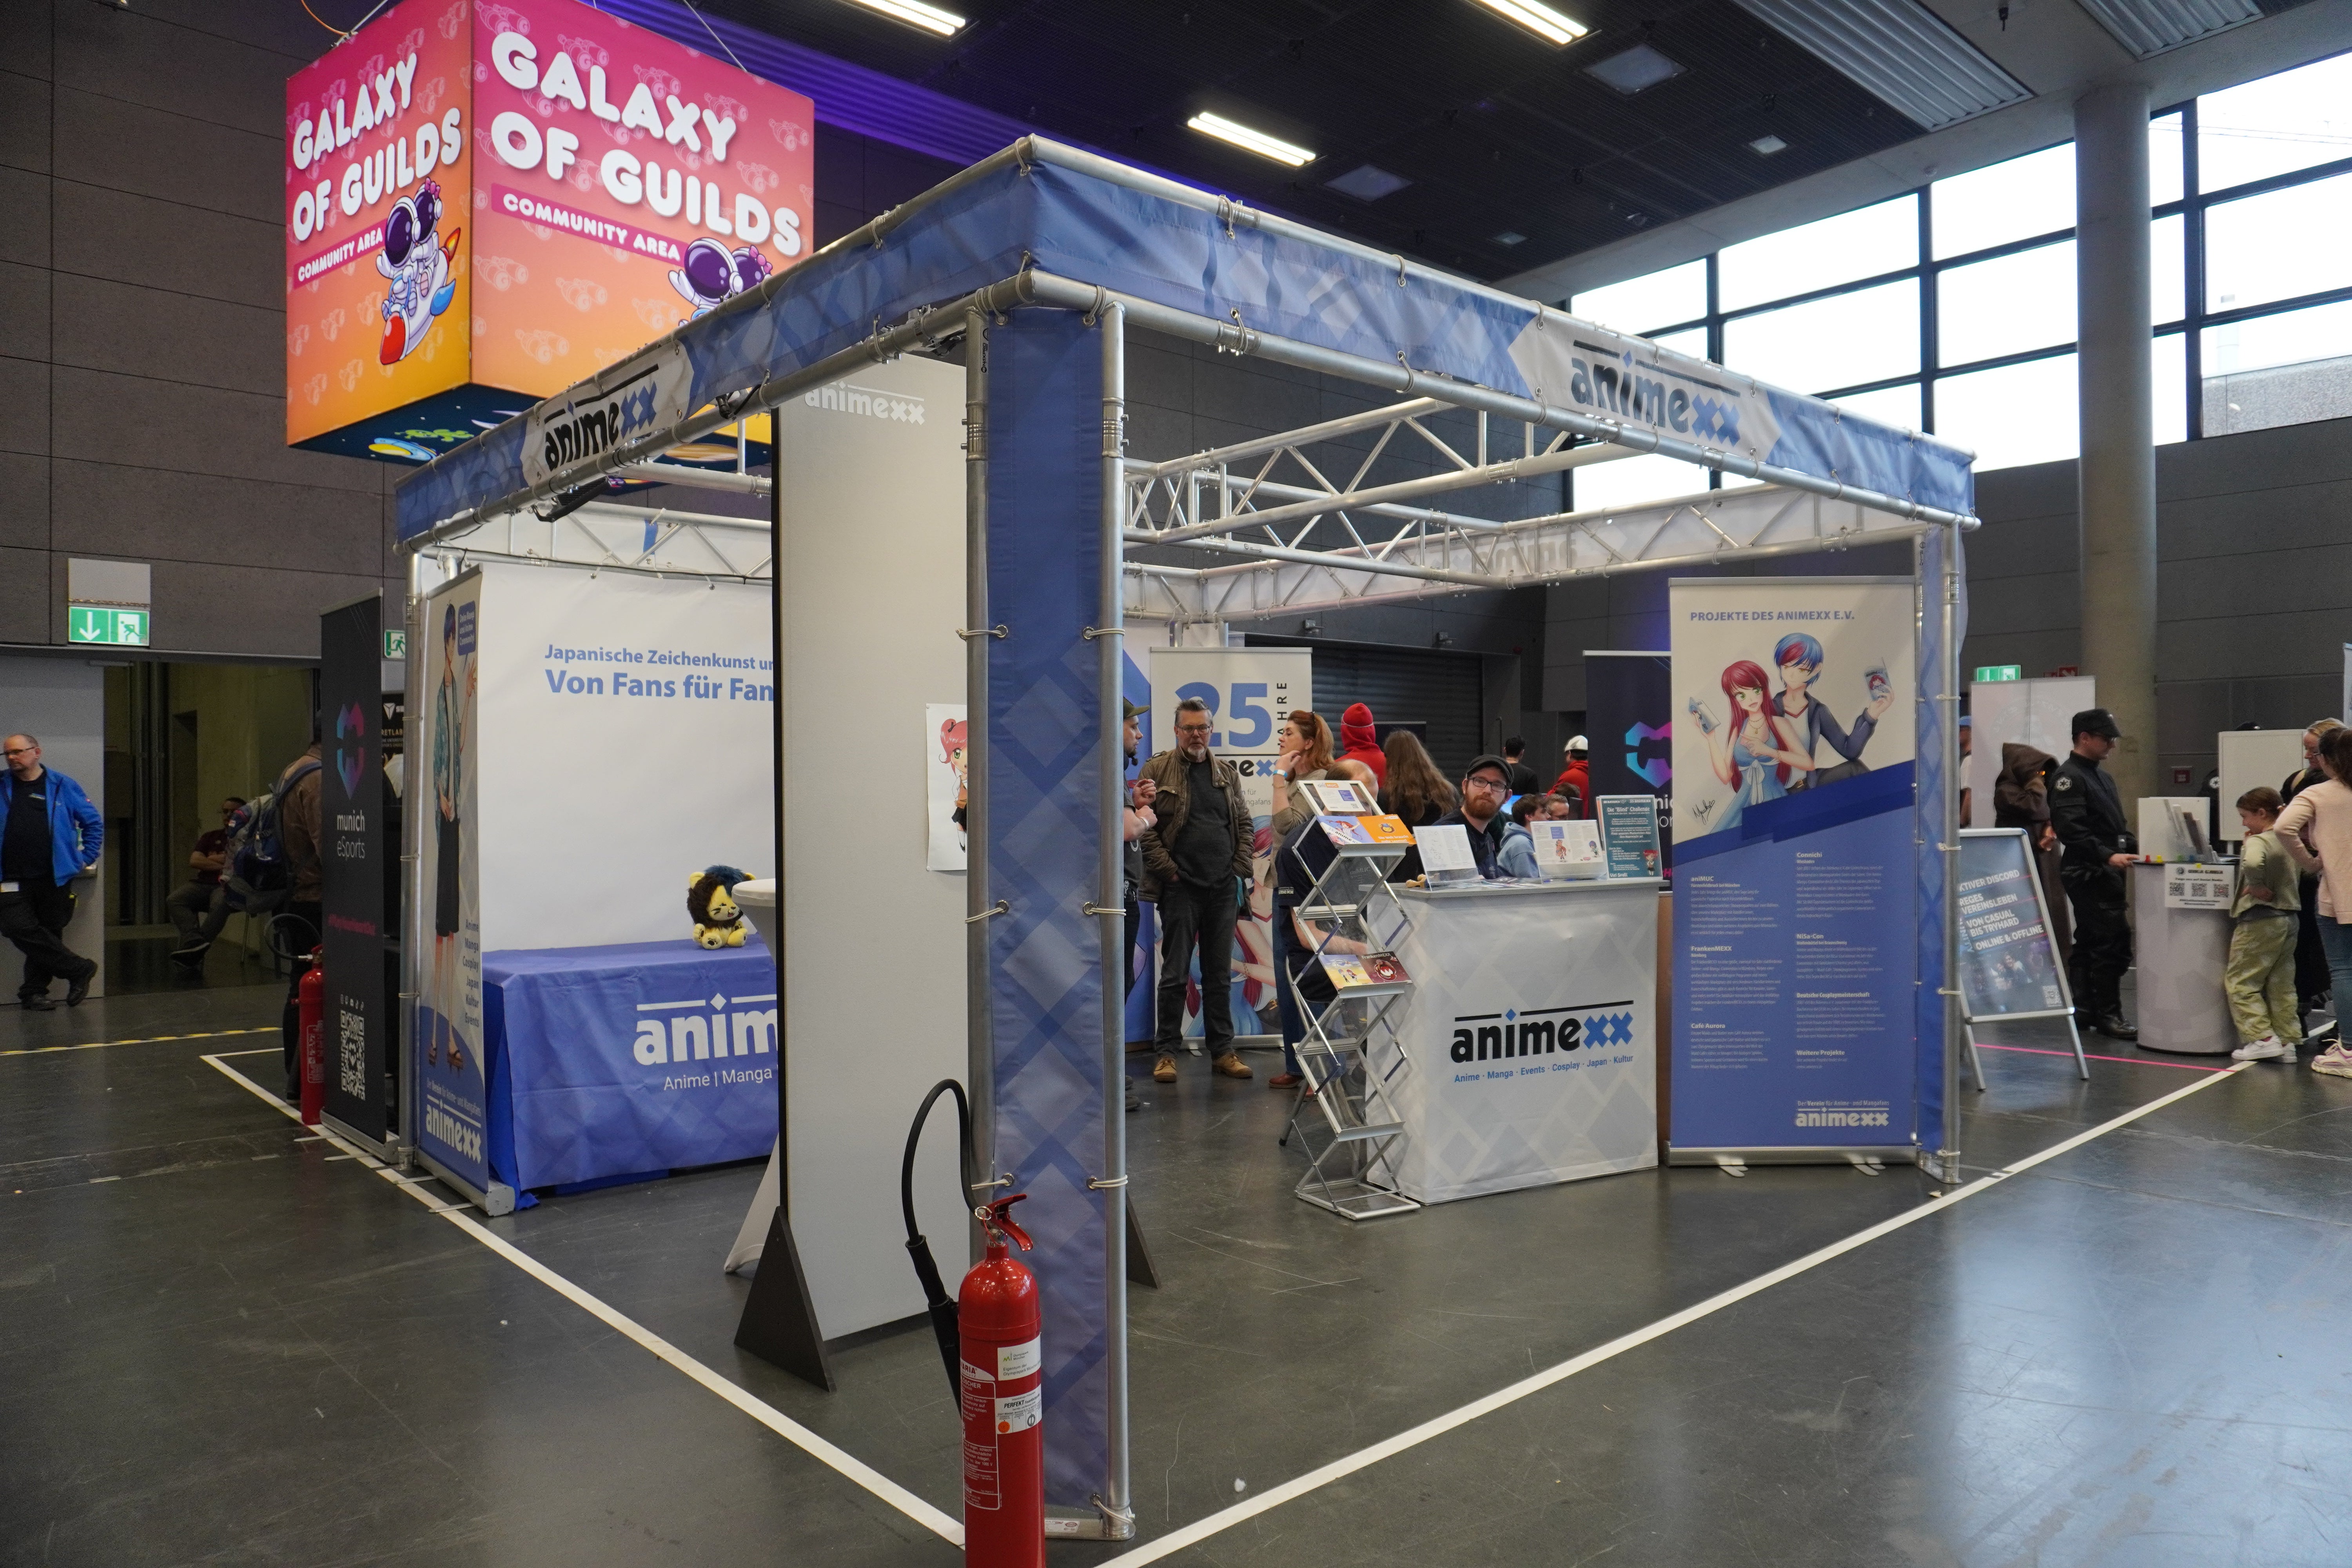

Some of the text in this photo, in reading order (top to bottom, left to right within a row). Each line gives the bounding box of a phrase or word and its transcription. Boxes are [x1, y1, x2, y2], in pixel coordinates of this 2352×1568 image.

[491, 31, 736, 162] GALAXY
[292, 52, 417, 170] GALAXY
[292, 107, 461, 241] OF GUILDS
[491, 111, 802, 257] OF GUILDS
[503, 192, 681, 262] COMMUNITY AREA
[298, 227, 383, 282] COMMUNITY AREA
[805, 381, 925, 425] animexx
[1570, 350, 1741, 447] animexx
[544, 380, 658, 472] animexx
[1690, 610, 1855, 621] PROJEKTE DES ANIMEXX E.V.
[544, 644, 643, 663] Japanische
[647, 650, 756, 670] Zeichenkunst
[545, 669, 604, 695] Von
[613, 672, 676, 698] Fans
[683, 674, 723, 699] für
[1175, 682, 1272, 748] 25
[337, 809, 365, 831] munich
[337, 835, 365, 861] eSports
[1985, 869, 2020, 883] DISCORD
[1959, 893, 1984, 907] REGES
[1961, 893, 2018, 915] VEREINSLEBEN
[465, 919, 479, 933] Anime
[1966, 909, 2015, 928] VON CASUAL
[1970, 917, 2019, 937] BIS TRYHARD
[465, 937, 479, 953] Manga
[1976, 936, 2005, 950] ONLINE
[2011, 925, 2044, 941] OFFLINE
[463, 956, 479, 973] Cosplay
[466, 976, 479, 990] Japan
[466, 993, 479, 1009] Kultur
[465, 1012, 479, 1028] Events
[1450, 1008, 1633, 1063] animexx
[663, 1067, 773, 1091] Anime Manga
[1454, 1054, 1633, 1083] Anime Manga Events Cosplay Japan Kultur
[1796, 1107, 1889, 1127] animexx
[426, 1099, 481, 1164] animexx
[1004, 1400, 1025, 1408] PERFEKT
